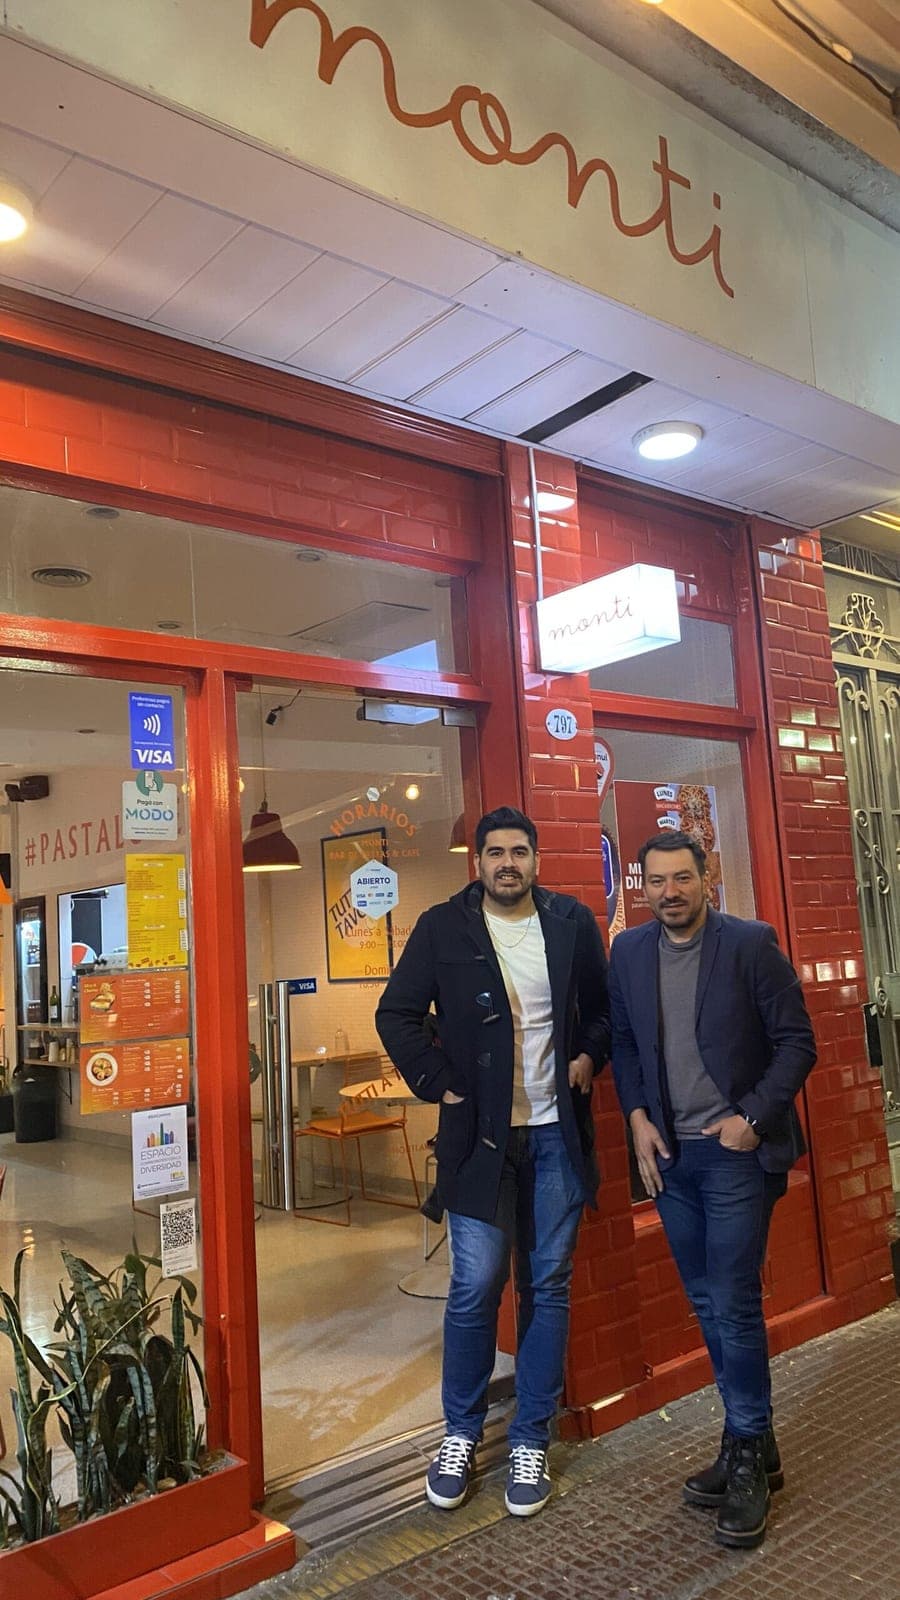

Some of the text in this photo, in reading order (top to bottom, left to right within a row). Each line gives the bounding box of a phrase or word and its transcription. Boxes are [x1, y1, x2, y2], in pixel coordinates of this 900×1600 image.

[250, 0, 734, 299] monti
[549, 595, 633, 641] monti
[553, 715, 573, 734] 797
[133, 748, 173, 765] VISA
[125, 808, 174, 821] MODO
[330, 802, 416, 838] HORARIOS
[25, 814, 141, 867] #PASTAL
[356, 876, 391, 885] ABIERTO
[328, 887, 352, 923] TUT
[364, 964, 393, 976] Domi
[299, 982, 315, 990] VISA
[140, 1145, 182, 1161] ESPACIO
[140, 1160, 182, 1175] DIVERSIDAD
